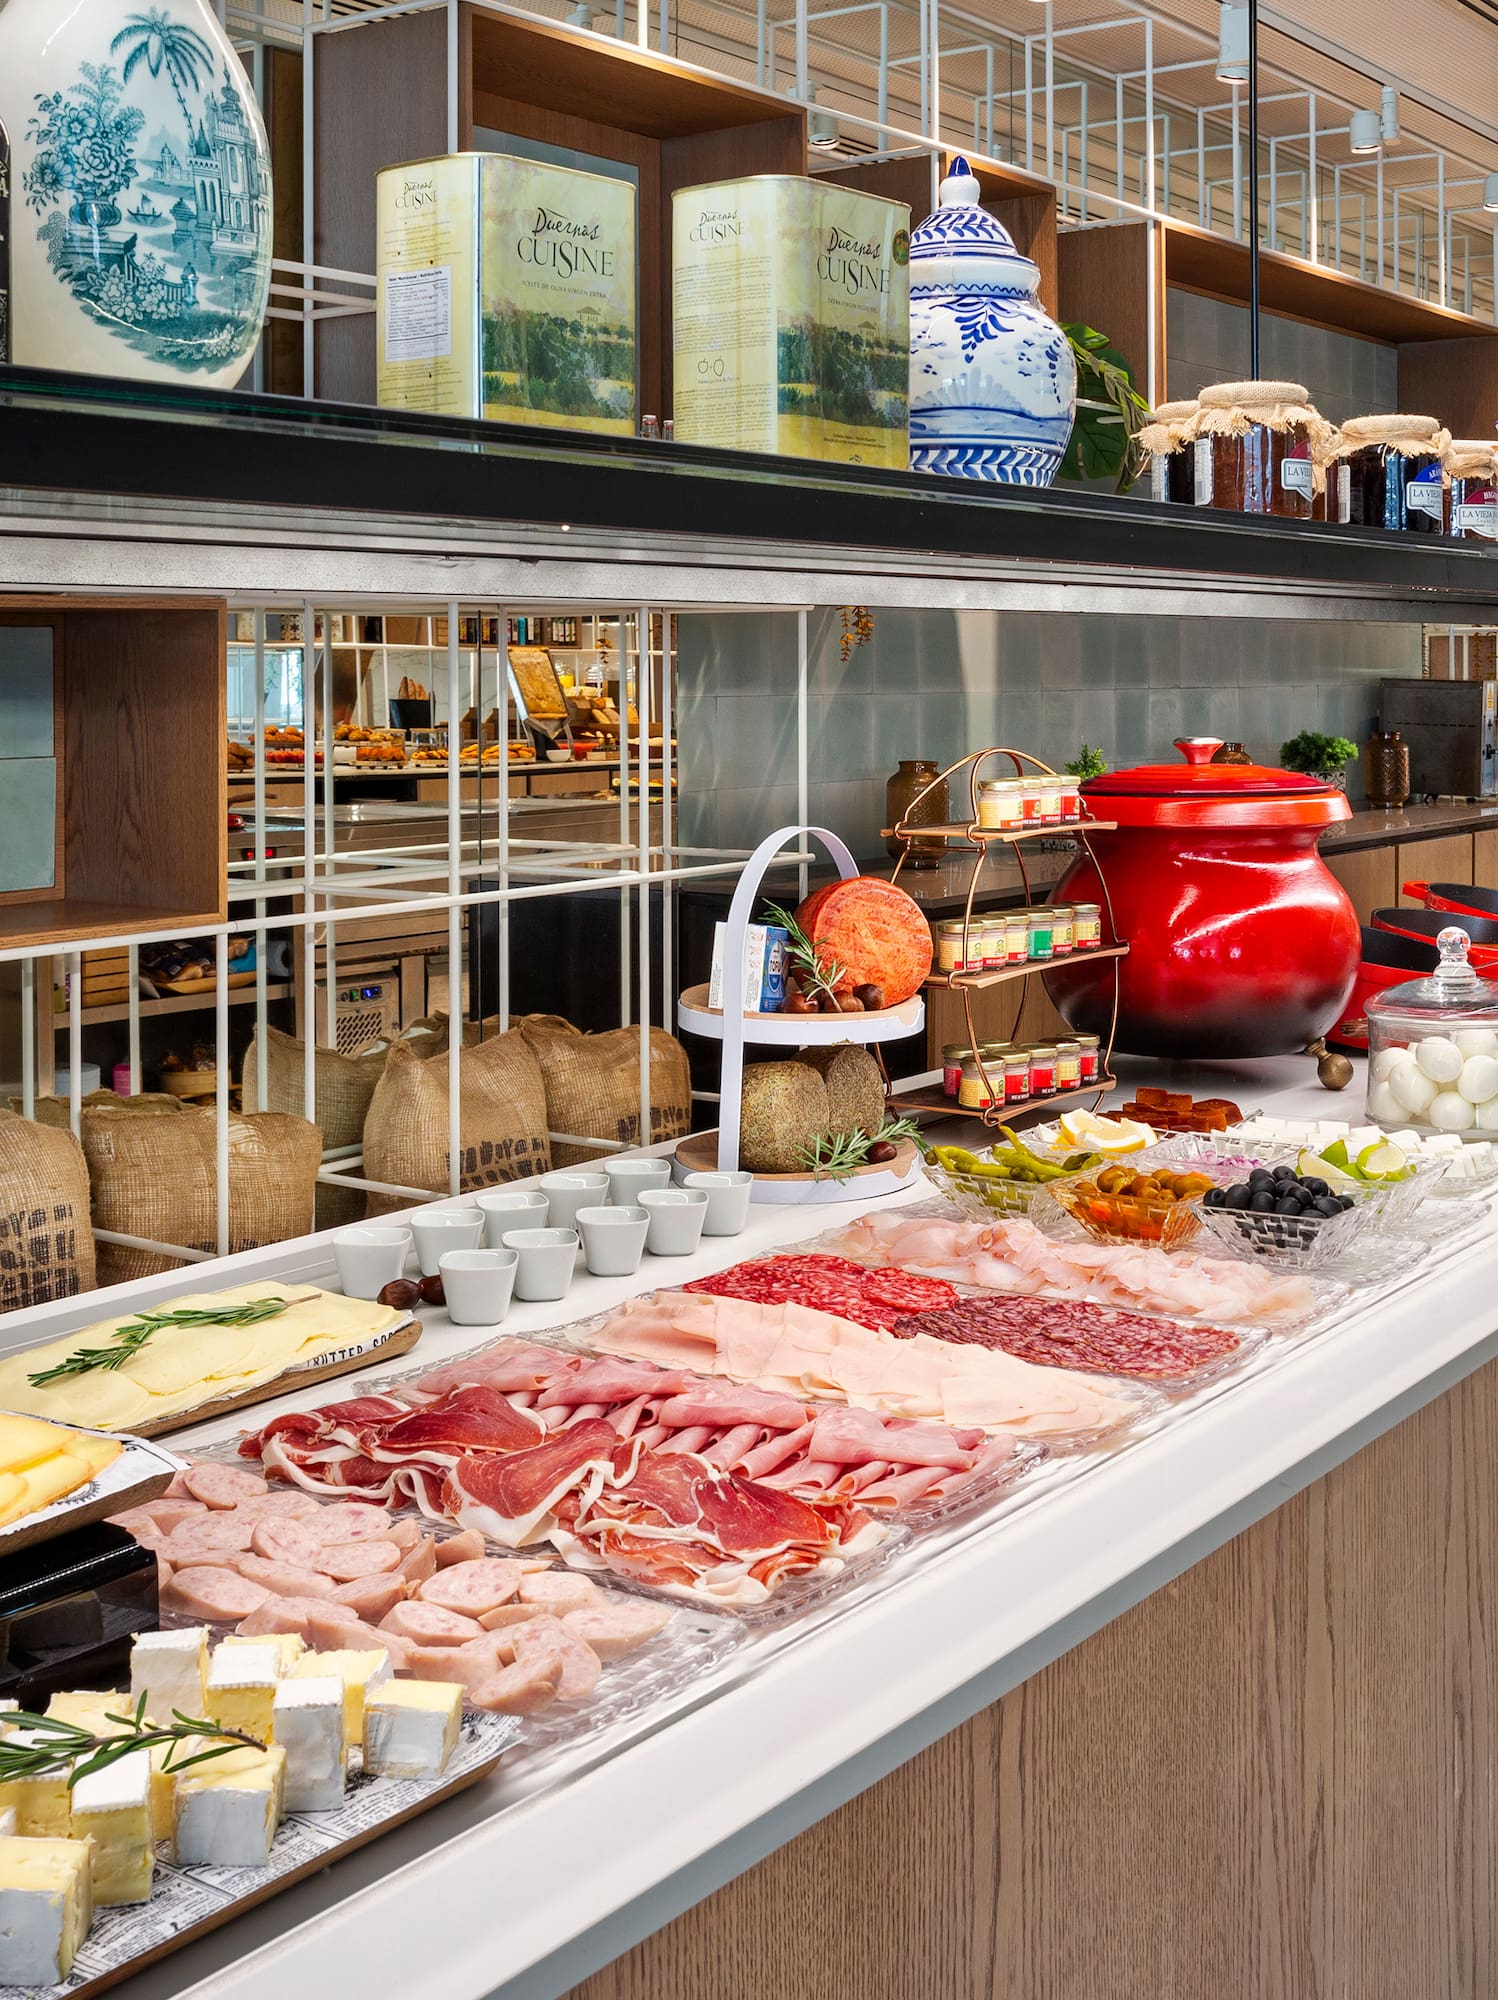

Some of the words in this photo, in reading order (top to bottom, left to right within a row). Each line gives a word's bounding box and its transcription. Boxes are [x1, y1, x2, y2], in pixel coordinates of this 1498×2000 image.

[689, 221, 744, 244] CUISINE
[517, 236, 614, 278] CUISINE
[817, 254, 890, 296] CUISINE
[1287, 466, 1298, 476] LA
[1413, 489, 1424, 498] LA
